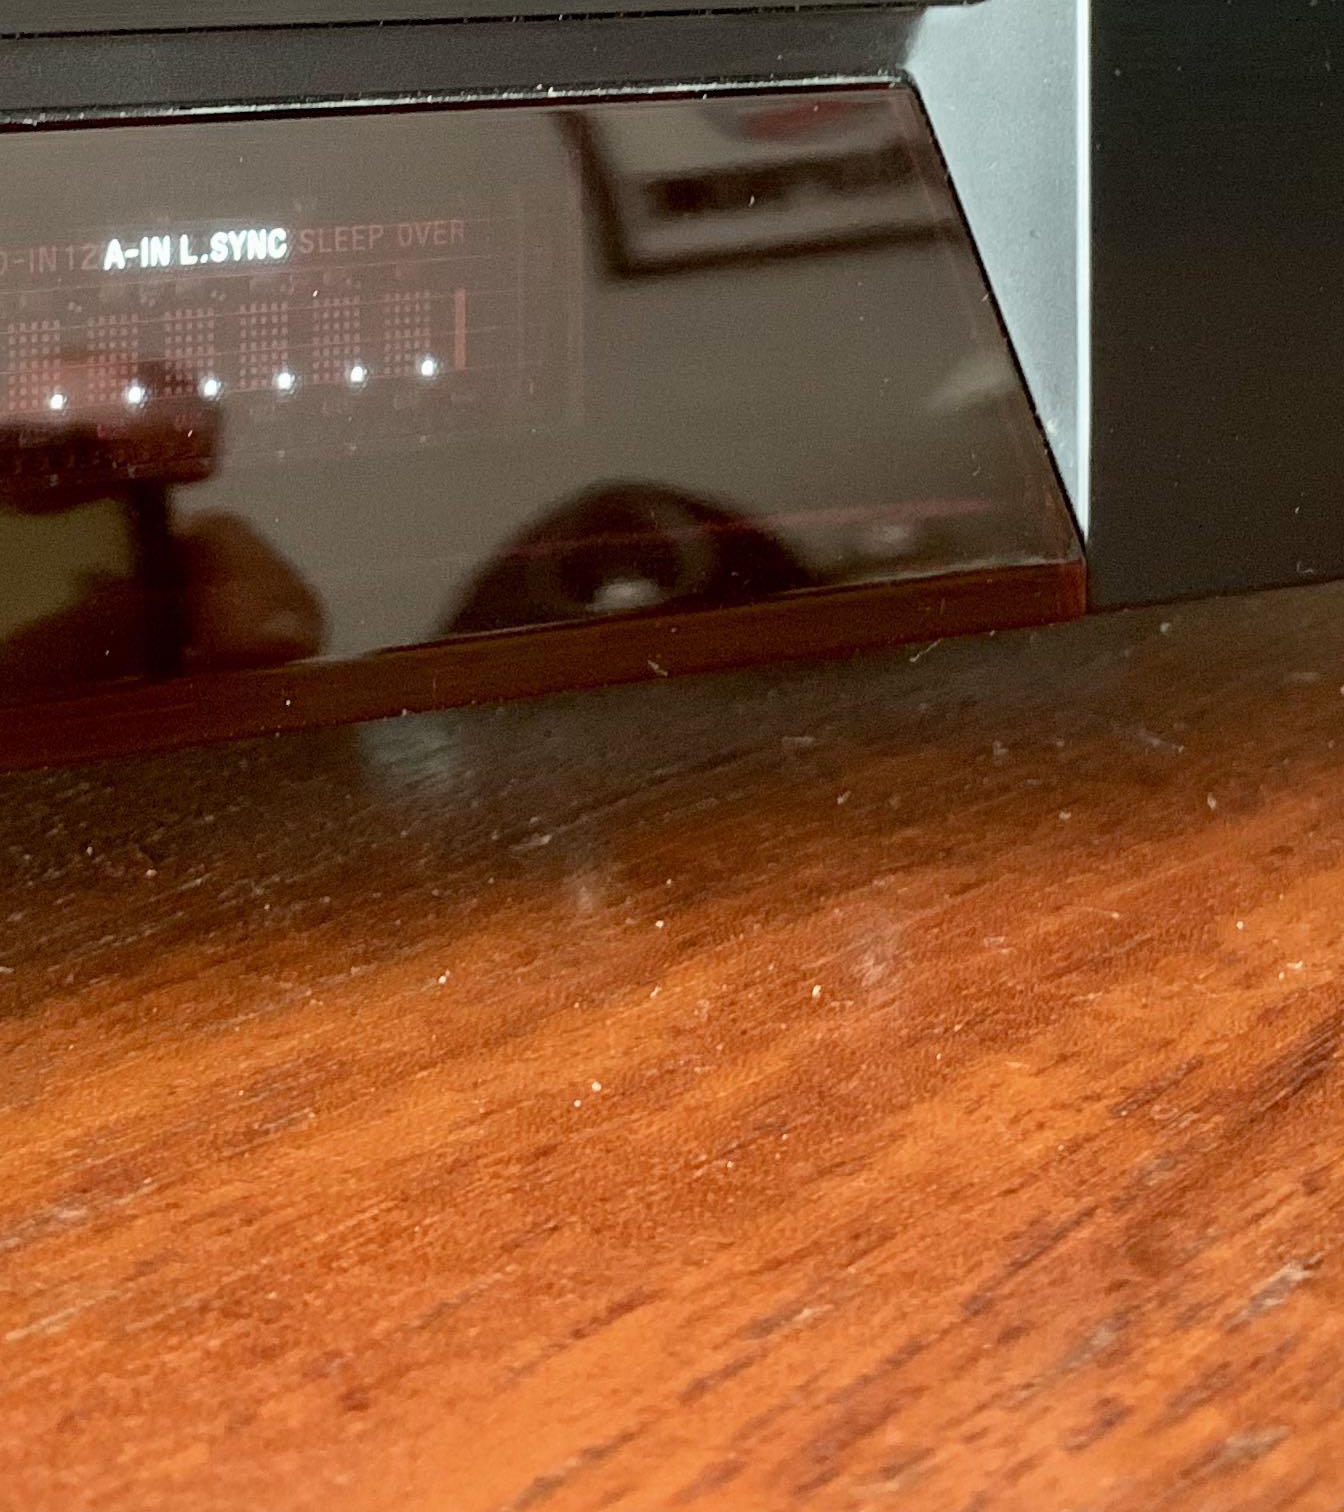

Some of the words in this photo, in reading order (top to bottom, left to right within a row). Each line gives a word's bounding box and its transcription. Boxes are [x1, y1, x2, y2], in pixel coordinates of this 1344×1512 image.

[103, 235, 171, 271] A-IN
[179, 227, 287, 266] L.SYNC
[299, 224, 383, 254] SLEEP
